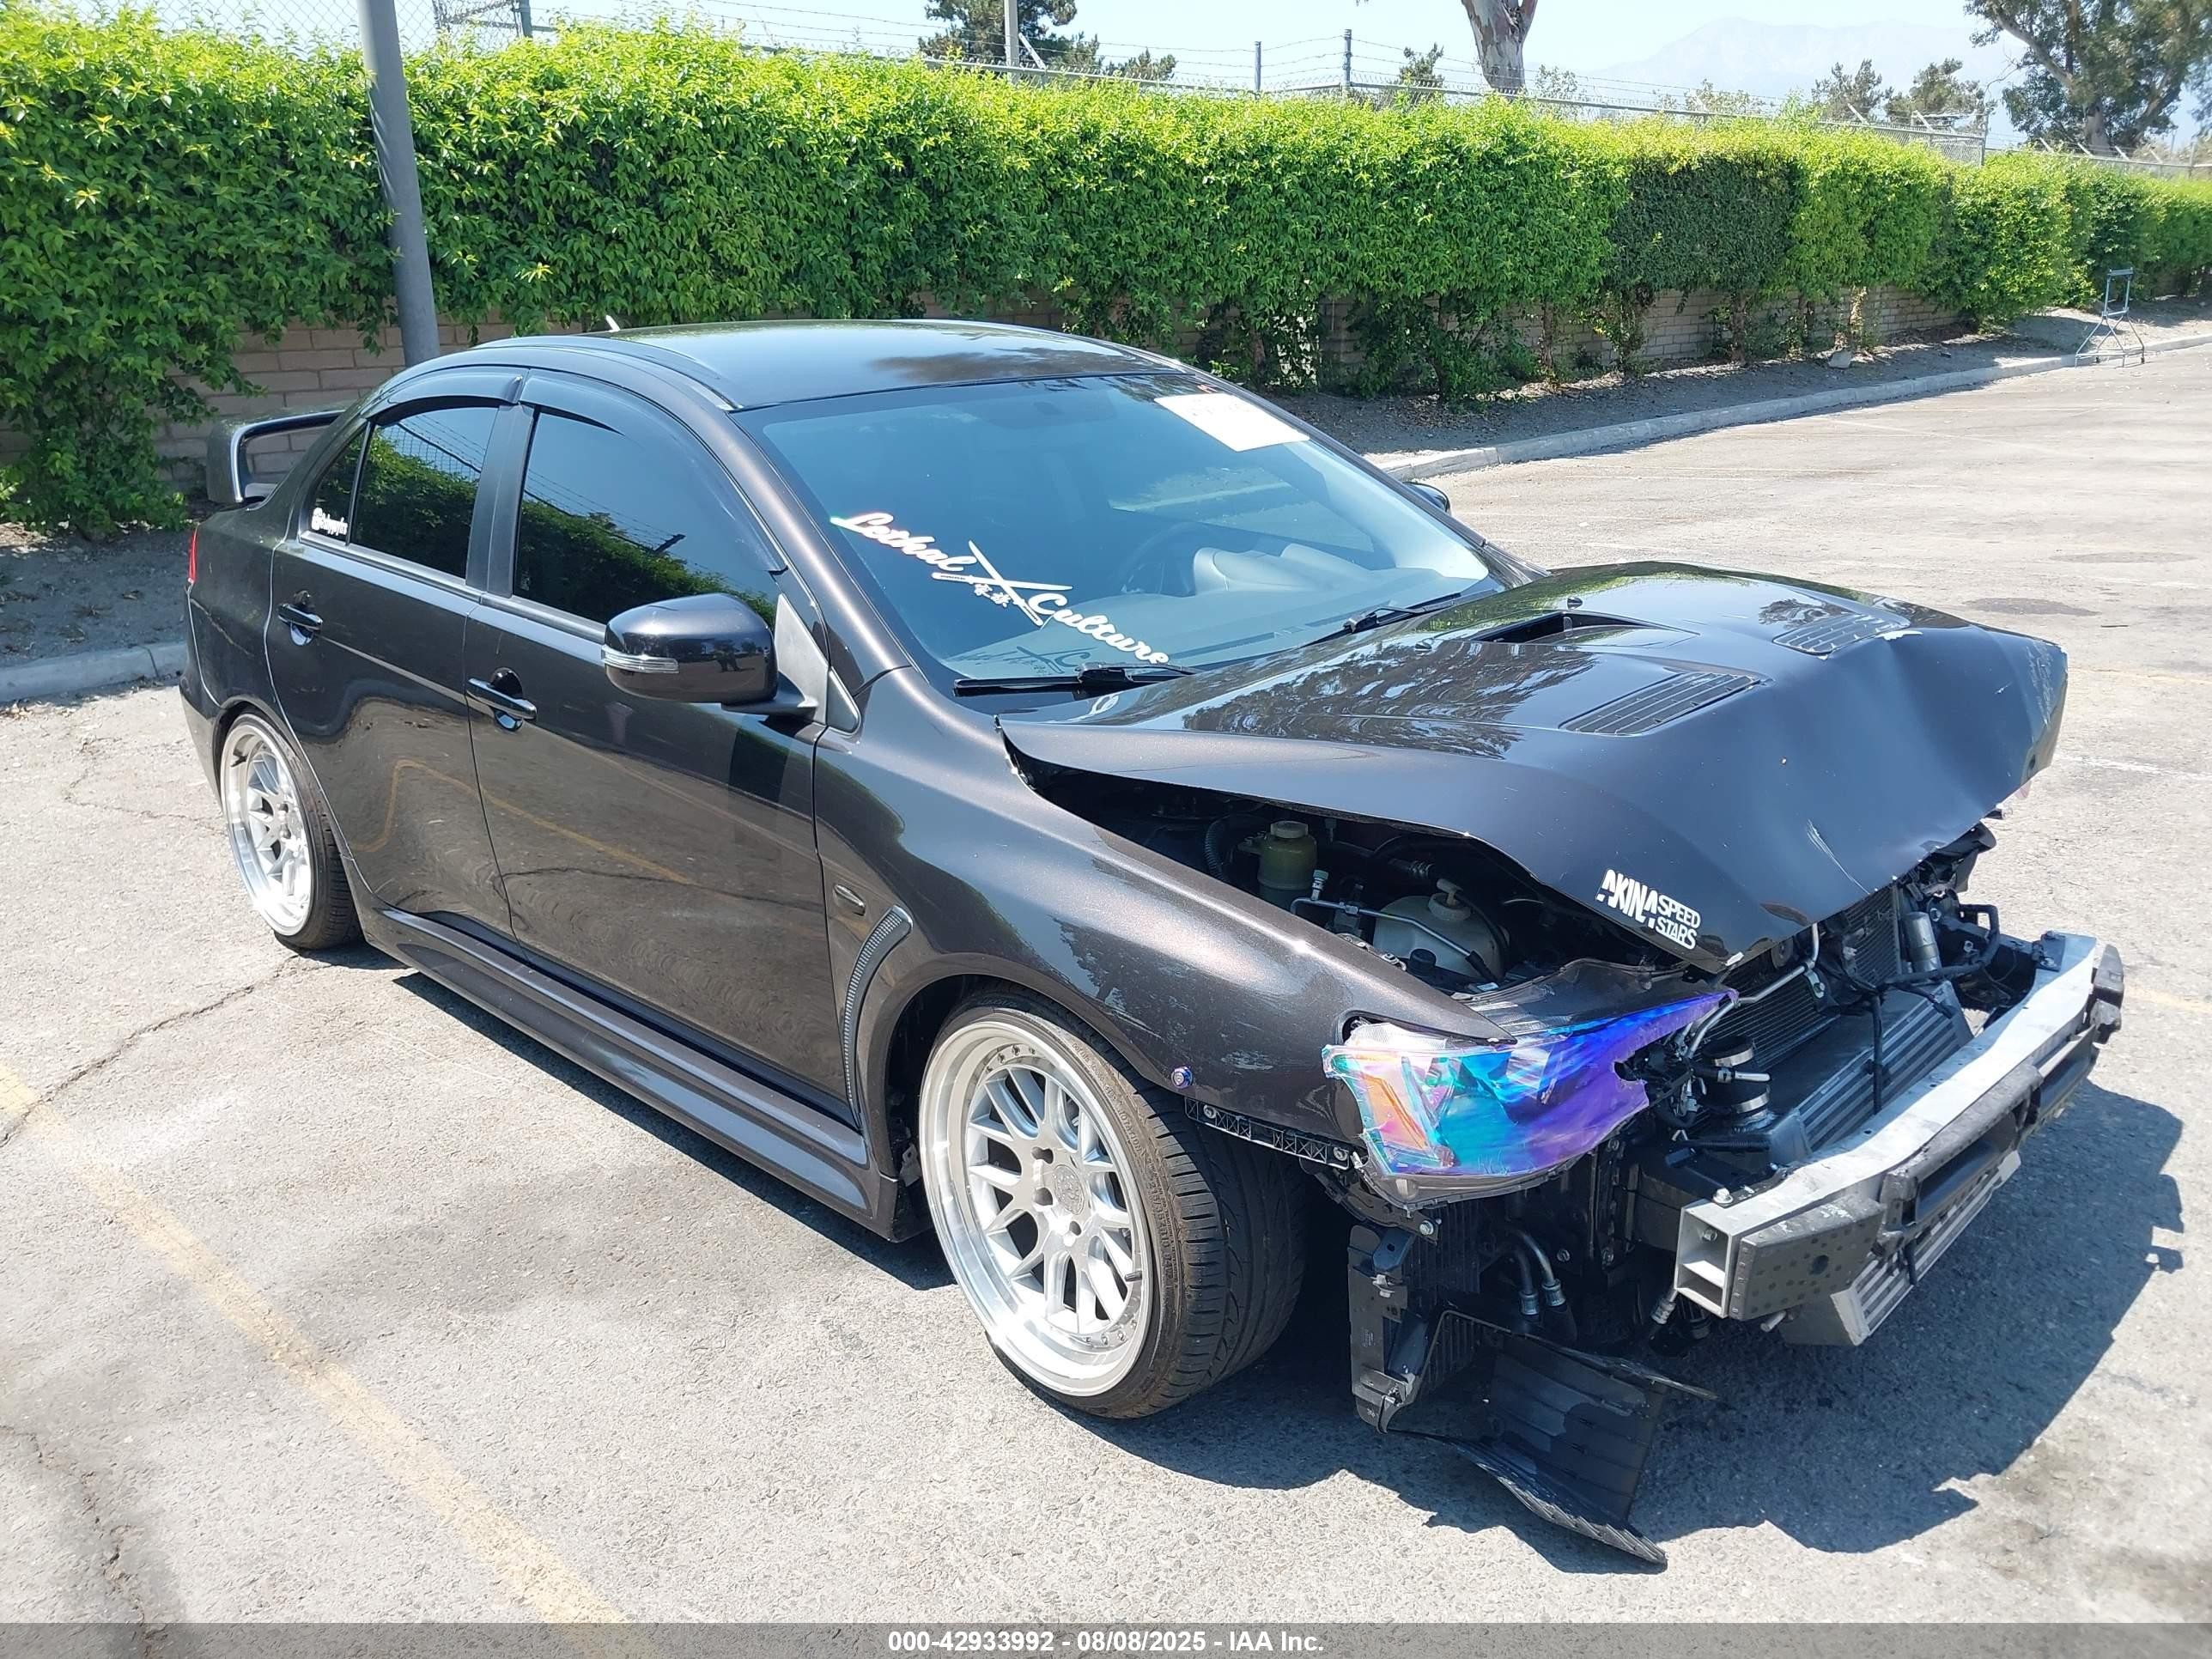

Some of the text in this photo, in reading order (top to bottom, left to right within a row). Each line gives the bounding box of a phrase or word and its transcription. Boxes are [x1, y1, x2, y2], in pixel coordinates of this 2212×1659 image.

[830, 512, 977, 572] Lethal
[1028, 592, 1170, 664] Culture
[1596, 869, 1658, 929] AKINA
[1657, 894, 1701, 929] SPEED
[1656, 917, 1698, 950] STARS
